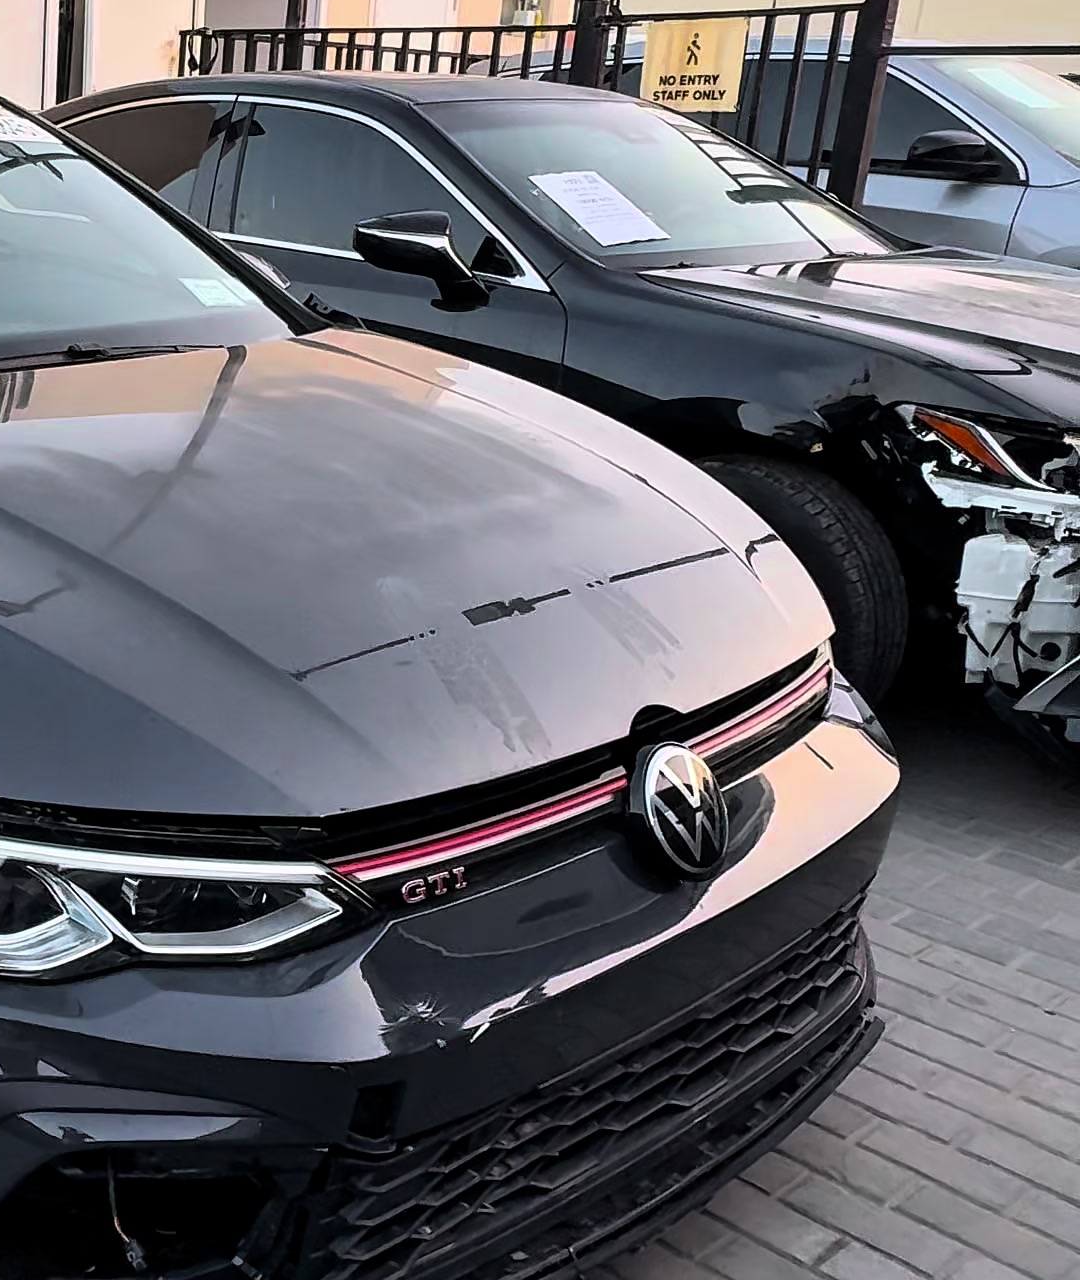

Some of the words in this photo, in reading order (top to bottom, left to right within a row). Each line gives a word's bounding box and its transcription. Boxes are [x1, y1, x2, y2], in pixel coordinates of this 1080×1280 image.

[659, 75, 676, 86] NO
[680, 74, 720, 85] ENTRY
[653, 90, 690, 101] STAFF
[693, 89, 727, 101] ONLY
[401, 866, 467, 904] GTI
